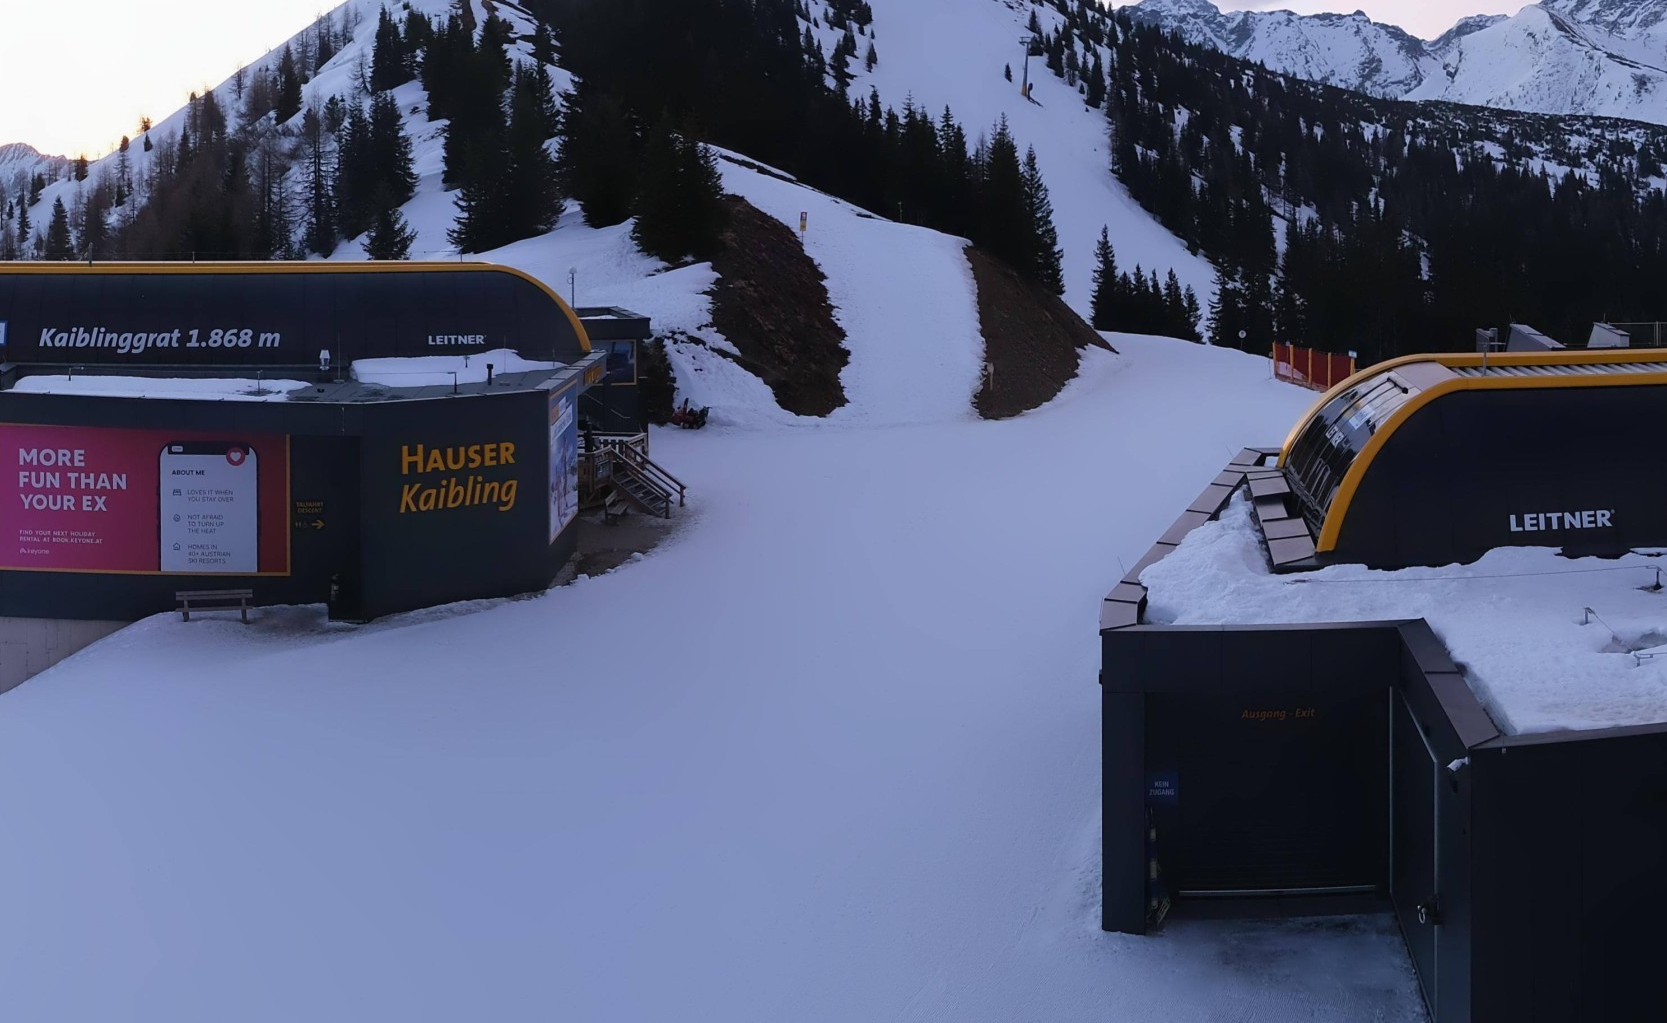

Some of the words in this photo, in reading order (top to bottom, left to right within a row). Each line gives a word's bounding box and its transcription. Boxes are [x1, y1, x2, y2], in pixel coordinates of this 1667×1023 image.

[38, 327, 181, 353] Kaiblinggrat
[186, 328, 253, 348] 1.868
[258, 332, 281, 348] m
[428, 334, 485, 345] LEITNER
[18, 448, 85, 467] MORE
[401, 441, 516, 475] HAUSER
[19, 471, 60, 488] FUN
[67, 473, 127, 490] THAN
[20, 494, 76, 511] YOUR
[82, 495, 107, 512] EX
[400, 475, 518, 514] Kaibling
[1509, 509, 1613, 532] LEITNER
[1241, 708, 1287, 721] Ausgang
[1295, 707, 1316, 718] Exit
[1149, 788, 1175, 796] ZUGANG
[1154, 780, 1169, 788] KEIN
